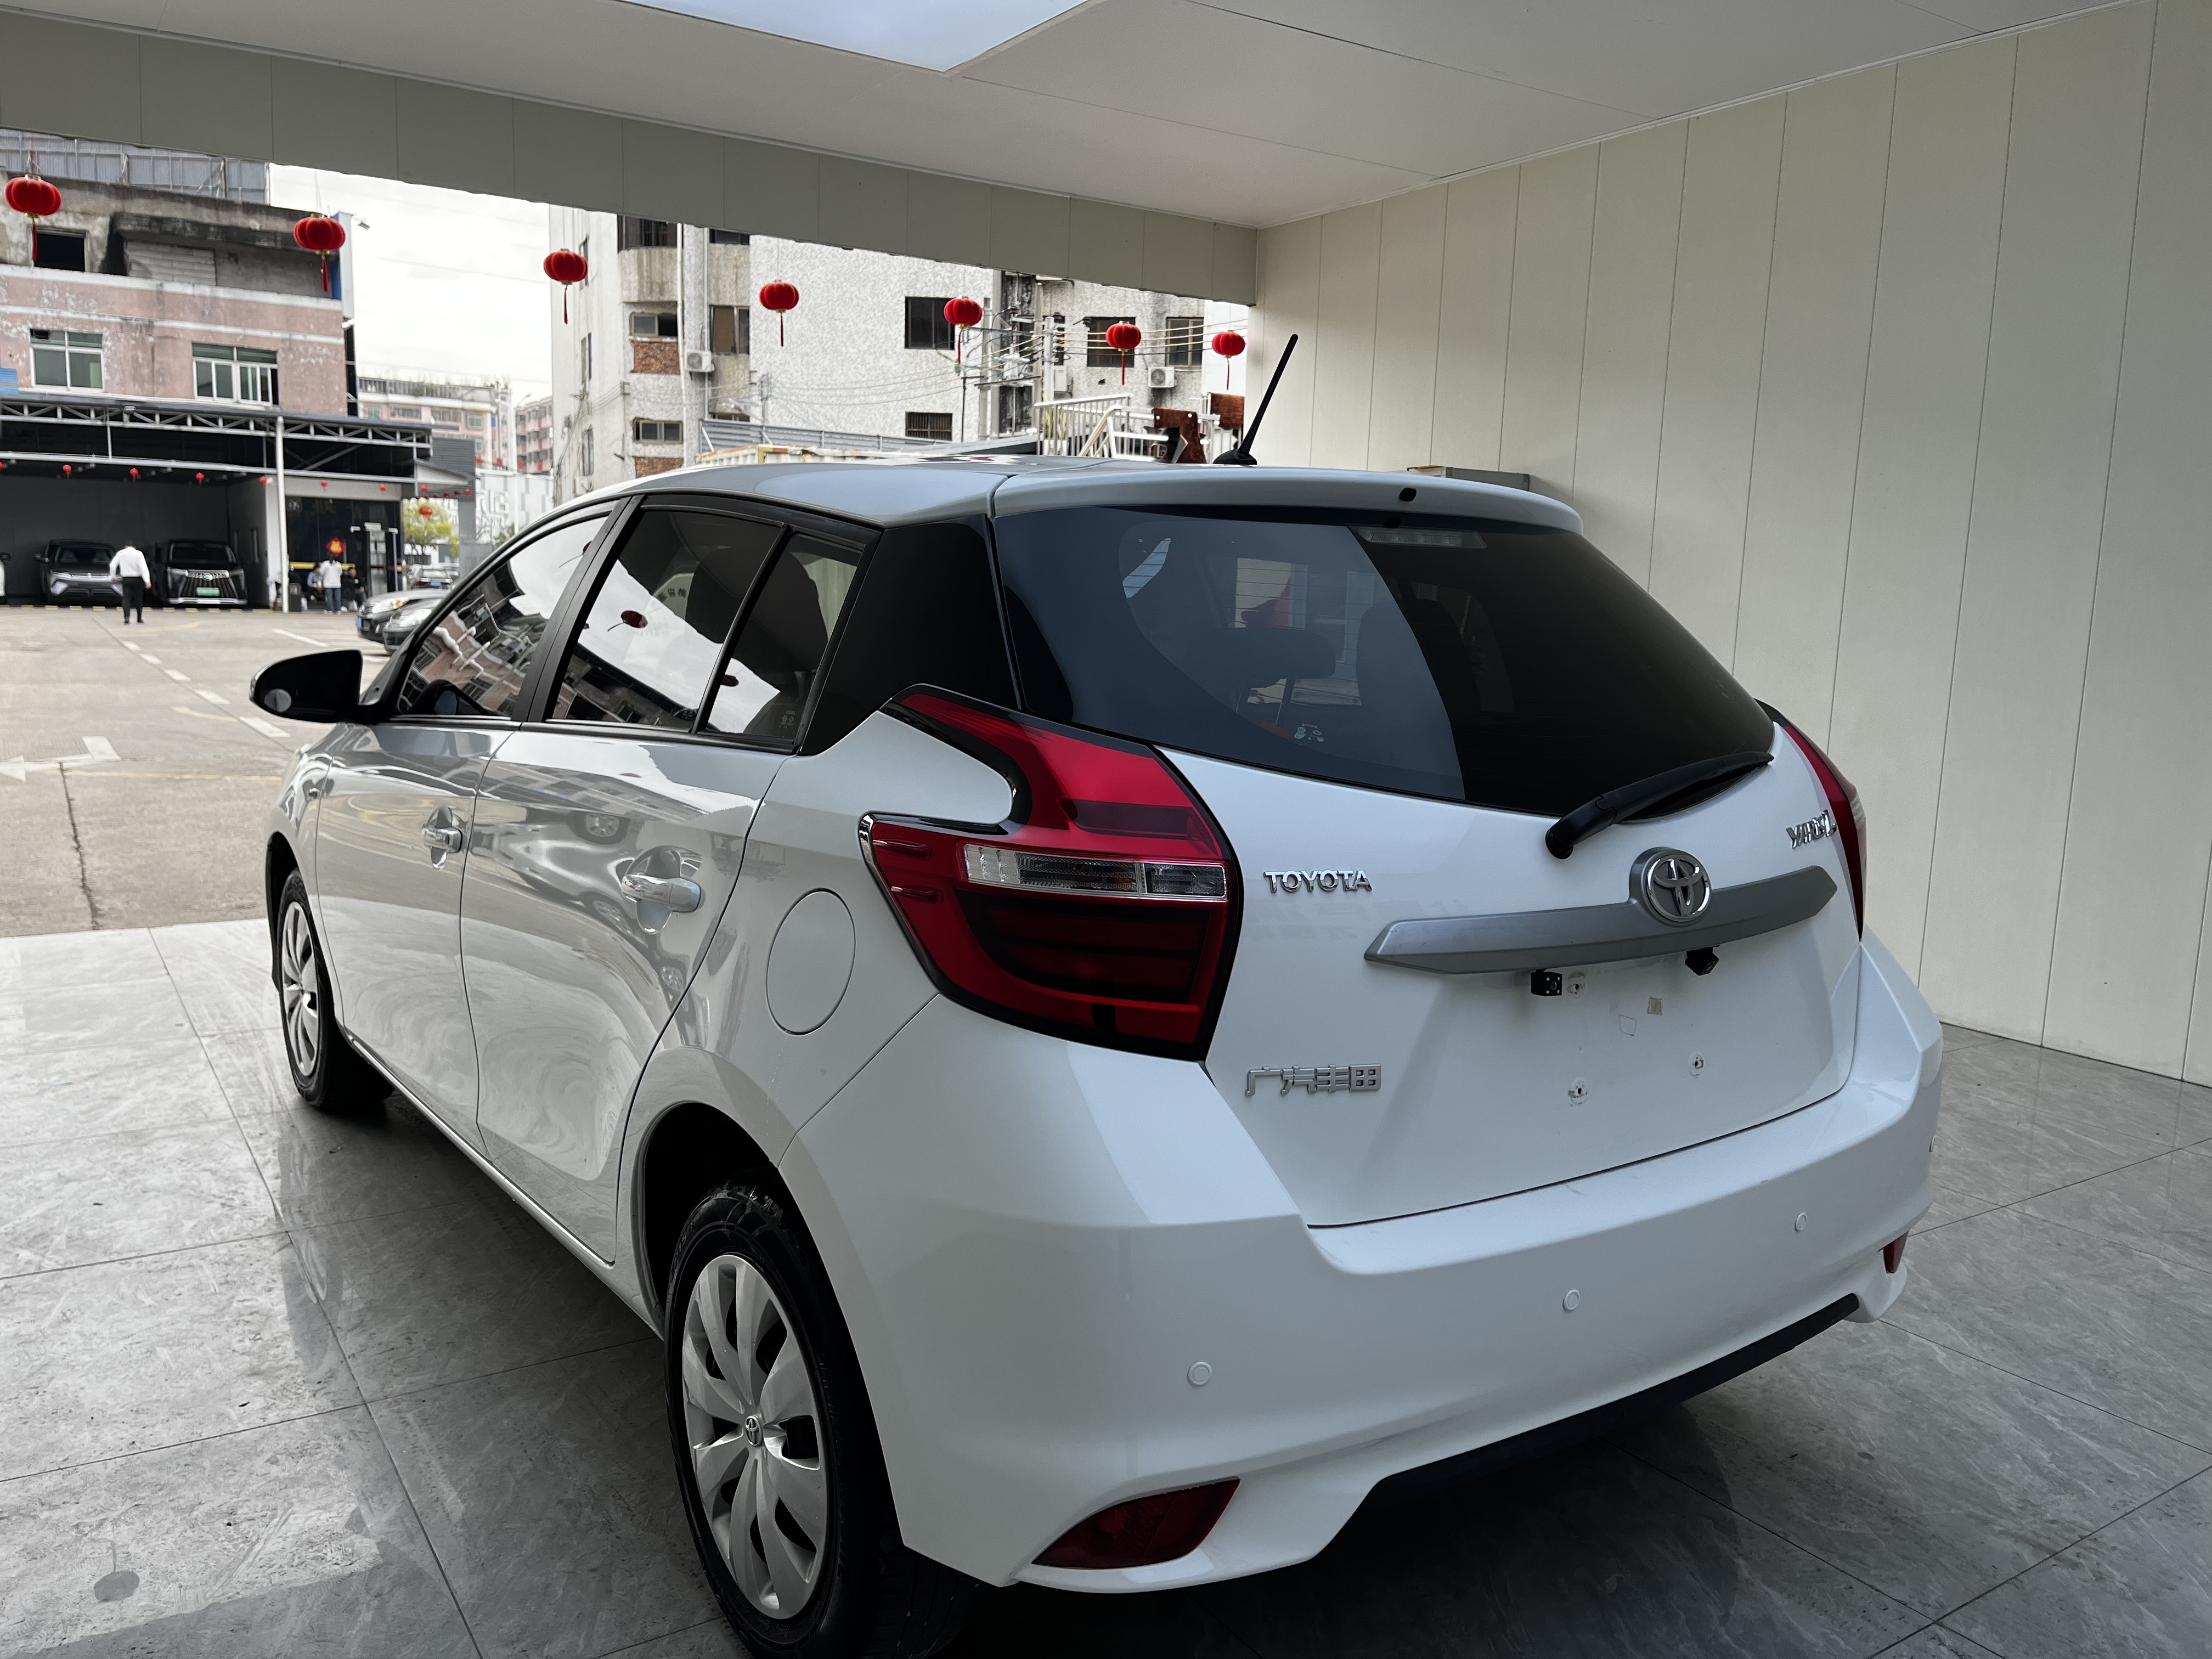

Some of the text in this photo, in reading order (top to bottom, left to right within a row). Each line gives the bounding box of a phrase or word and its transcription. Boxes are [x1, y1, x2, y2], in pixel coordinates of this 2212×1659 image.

[1263, 870, 1372, 893] TOYOTA
[1245, 1063, 1381, 1097] 广汽丰田
